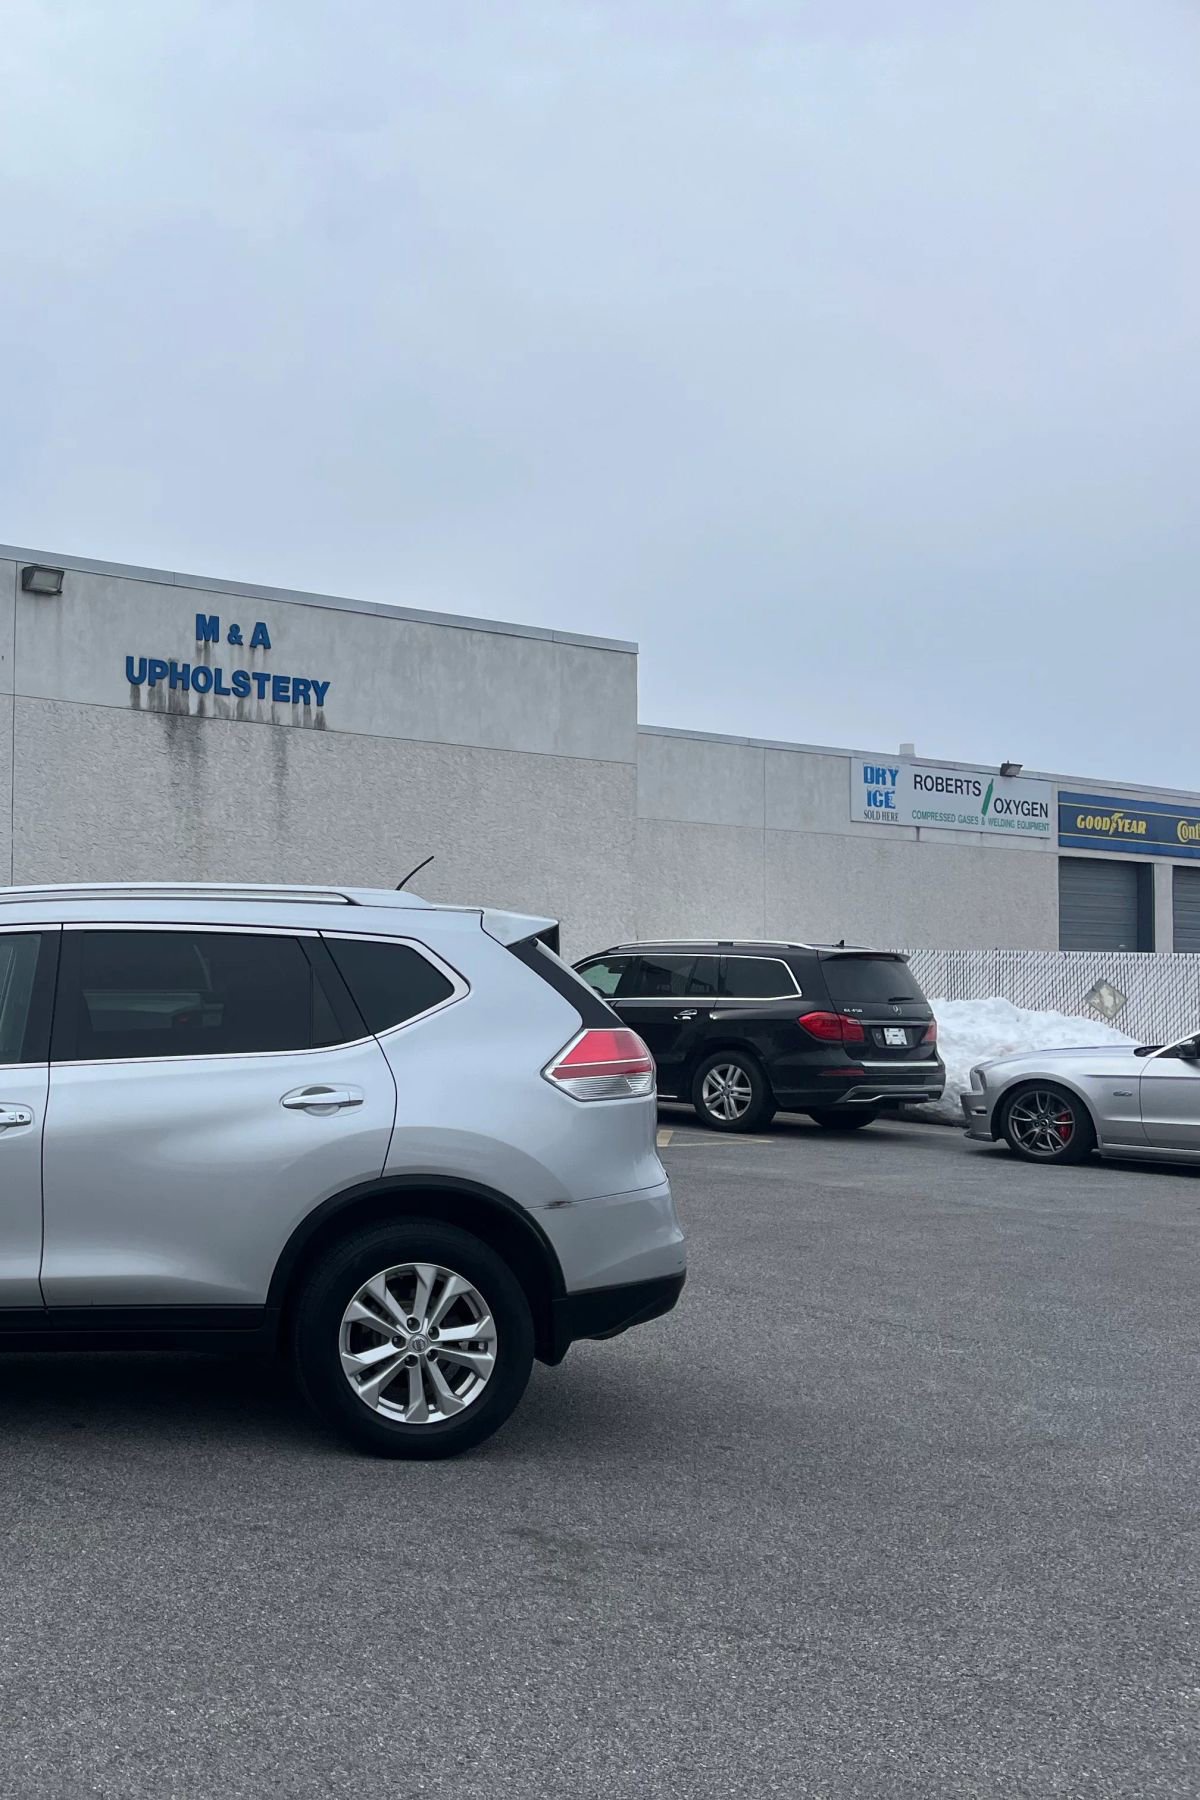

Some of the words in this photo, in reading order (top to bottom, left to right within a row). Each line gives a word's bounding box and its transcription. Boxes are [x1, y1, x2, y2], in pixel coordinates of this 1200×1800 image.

[195, 613, 220, 643] M
[227, 623, 244, 646] &
[249, 621, 272, 650] A
[125, 655, 331, 707] UPHOLSTERY
[863, 765, 899, 787] DRY
[913, 774, 982, 797] ROBERTS
[866, 789, 896, 809] ICE
[993, 797, 1049, 819] OXYGEN
[863, 809, 880, 821] SOLD
[881, 810, 899, 822] HERE
[911, 809, 956, 823] COMPRESSED
[957, 814, 979, 826] GASES
[987, 817, 1016, 829] WELDING
[1017, 820, 1050, 832] EQUIPMENT
[1076, 813, 1147, 835] GOODYEAR
[1176, 820, 1200, 843] Cont
